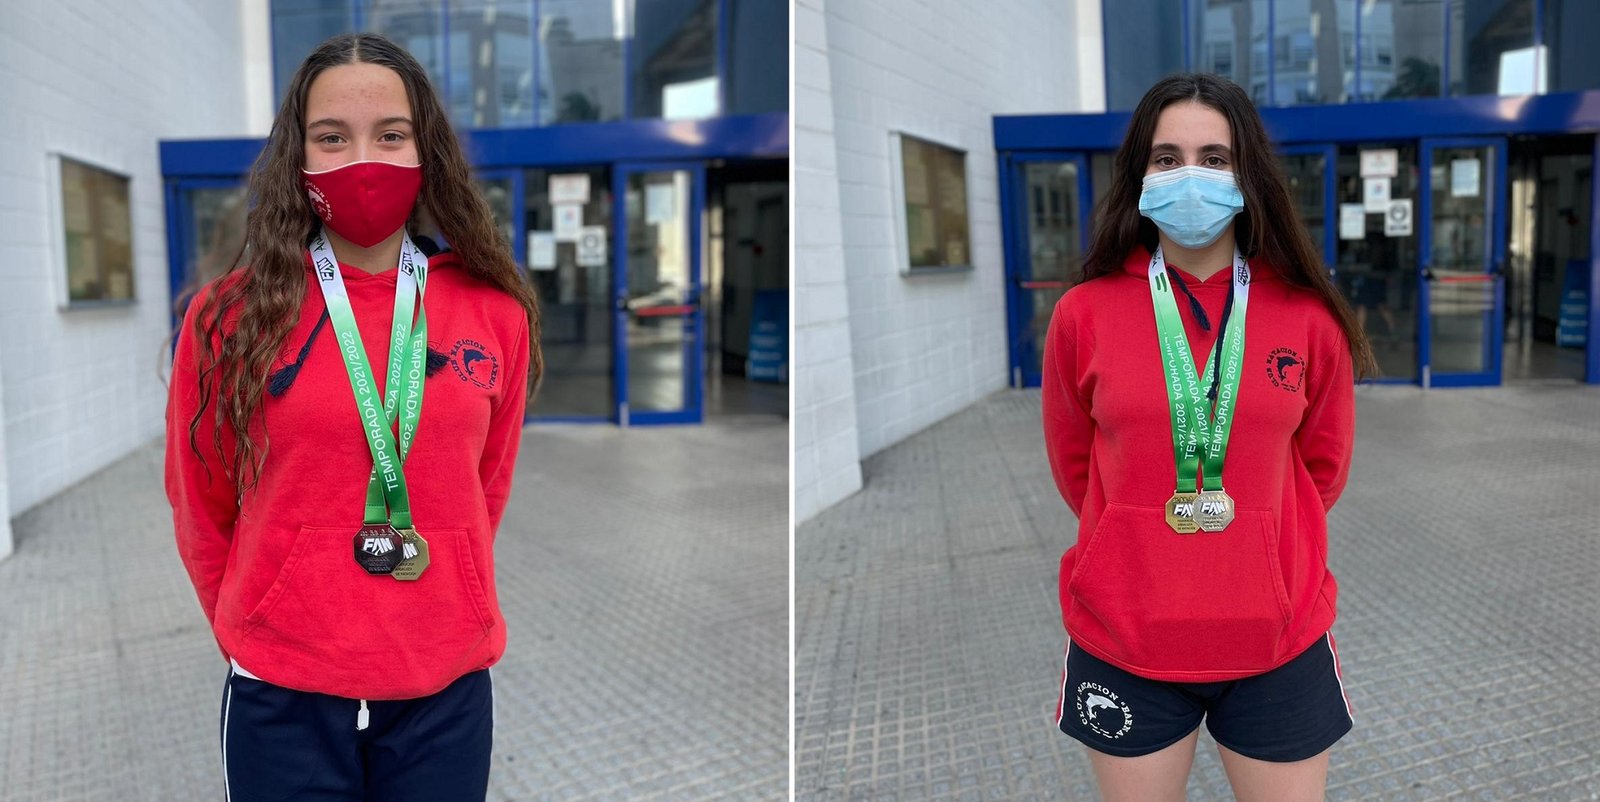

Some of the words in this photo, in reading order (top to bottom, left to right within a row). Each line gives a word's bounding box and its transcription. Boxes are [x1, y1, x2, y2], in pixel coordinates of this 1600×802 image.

[317, 257, 335, 282] FAN
[341, 330, 371, 395] 2021/2022
[391, 323, 407, 386] 2021/2022
[405, 330, 423, 419] TEMPORADA
[1174, 332, 1201, 405] TEMPORADA
[1209, 383, 1234, 460] TEMPORADA
[1226, 326, 1242, 381] 2021/2022
[363, 396, 399, 492] TEMPORADA
[1174, 503, 1194, 519] FA
[1201, 501, 1226, 517] FAN
[362, 537, 394, 557] FAN
[1116, 705, 1133, 736] BAENA
